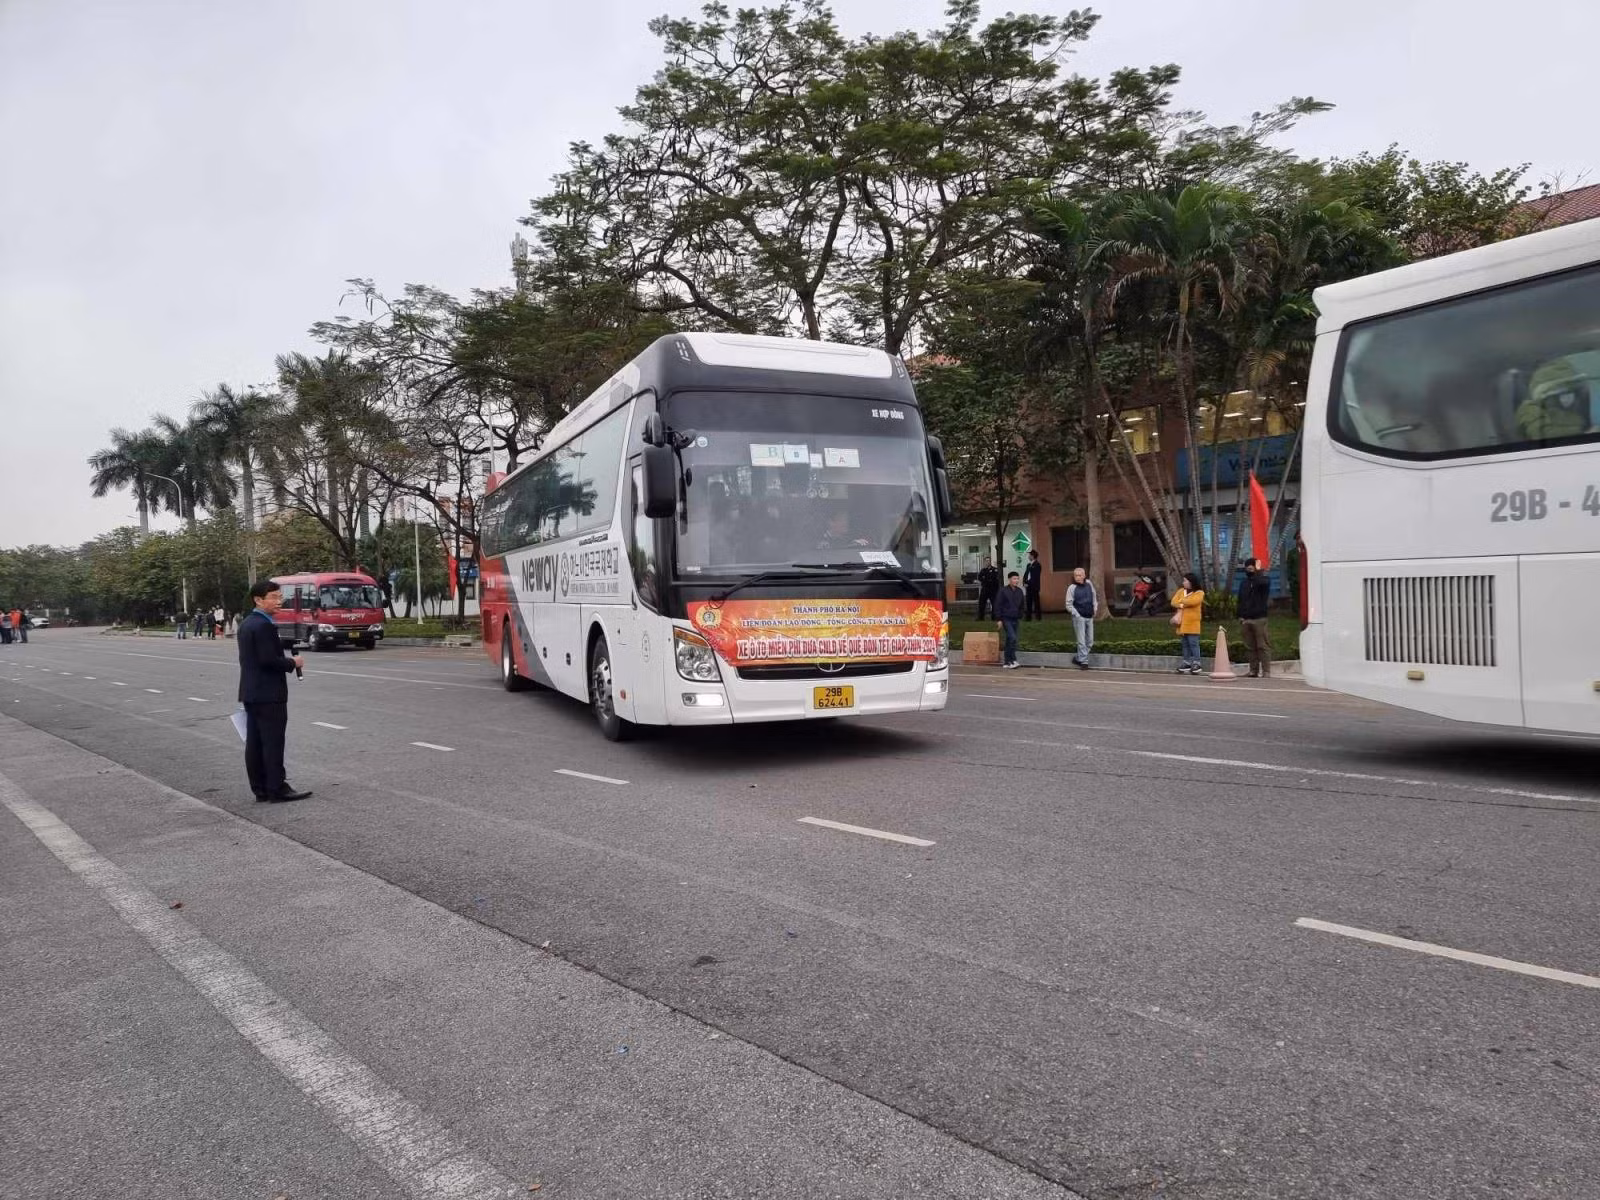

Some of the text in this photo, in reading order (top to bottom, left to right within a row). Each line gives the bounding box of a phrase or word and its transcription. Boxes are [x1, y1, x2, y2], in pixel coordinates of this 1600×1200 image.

[872, 409, 879, 417] XE
[1490, 488, 1548, 523] 29B
[1582, 484, 1600, 517] 4
[737, 640, 749, 658] XE
[825, 687, 843, 697] 29B
[818, 697, 849, 708] 624.41
